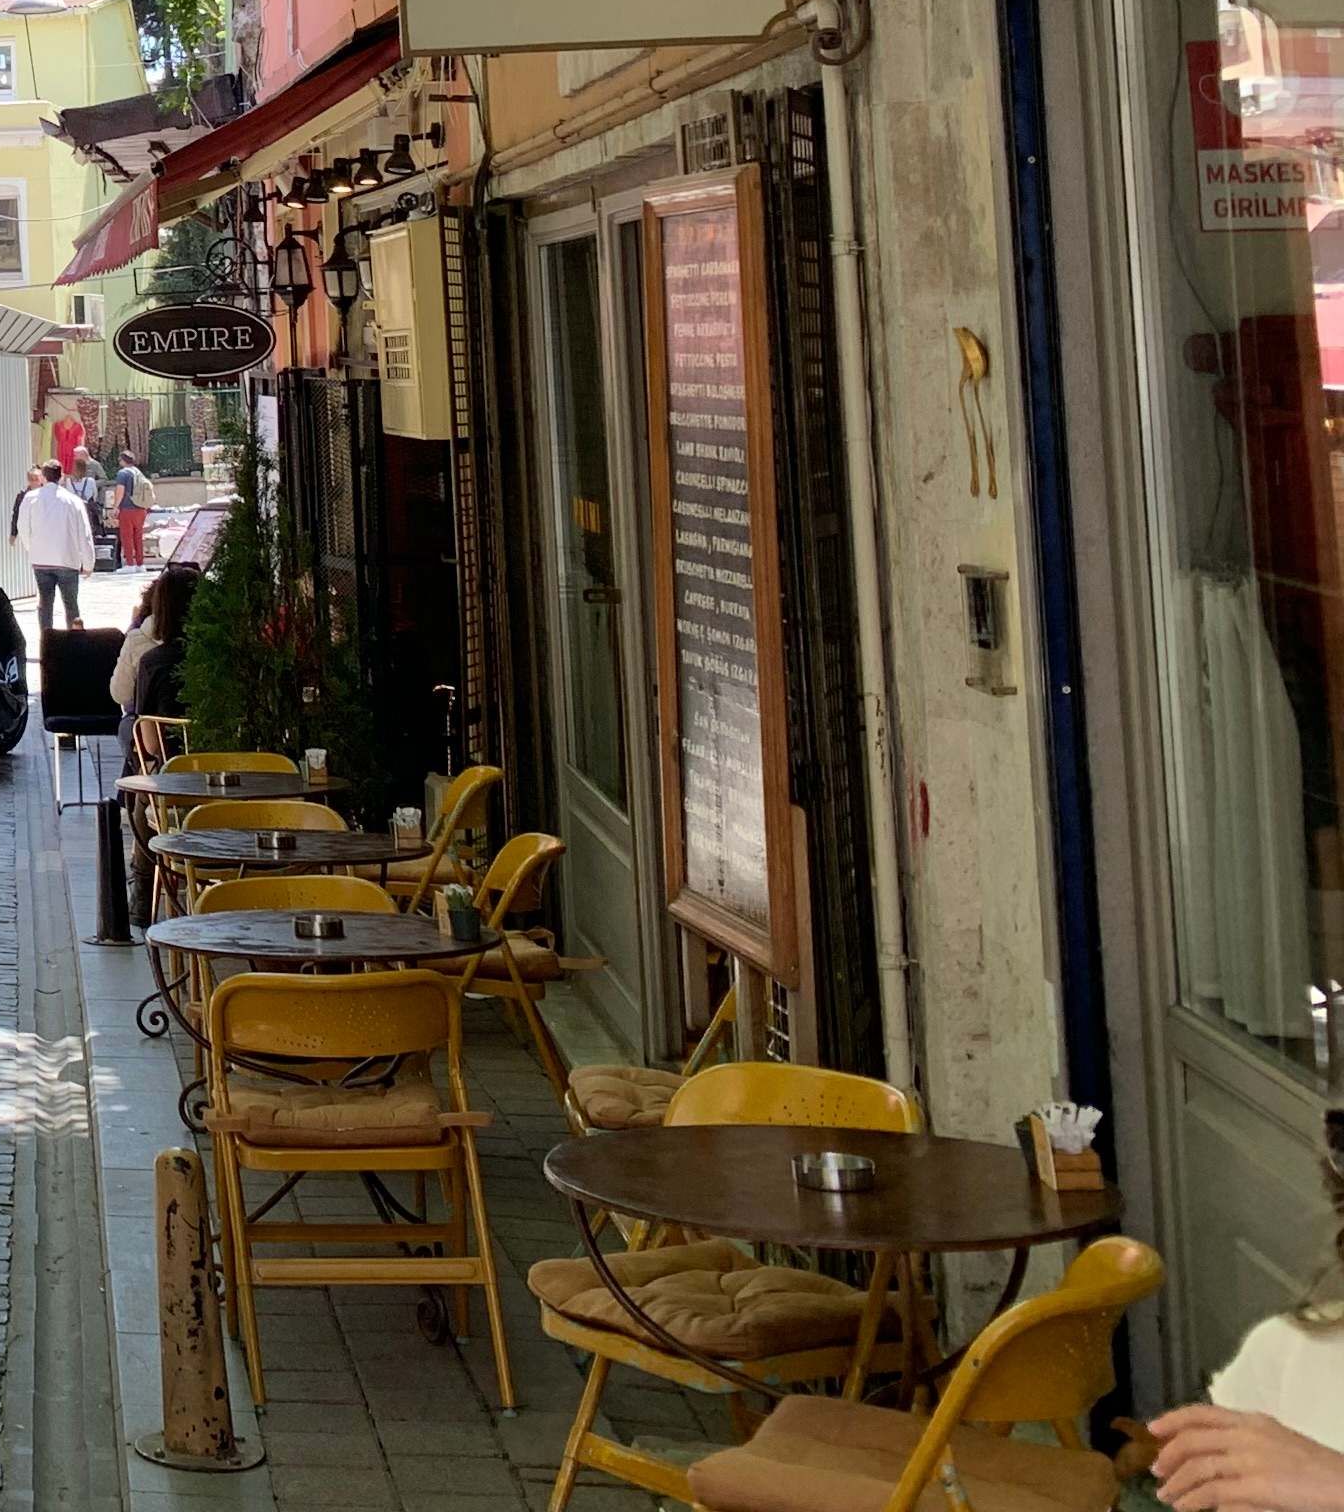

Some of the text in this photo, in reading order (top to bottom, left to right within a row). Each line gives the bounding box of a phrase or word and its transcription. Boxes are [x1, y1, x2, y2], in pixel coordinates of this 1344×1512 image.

[1213, 192, 1308, 219] GİRİLME
[129, 326, 254, 355] EMPIRE
[716, 568, 753, 589] MOZZARELL
